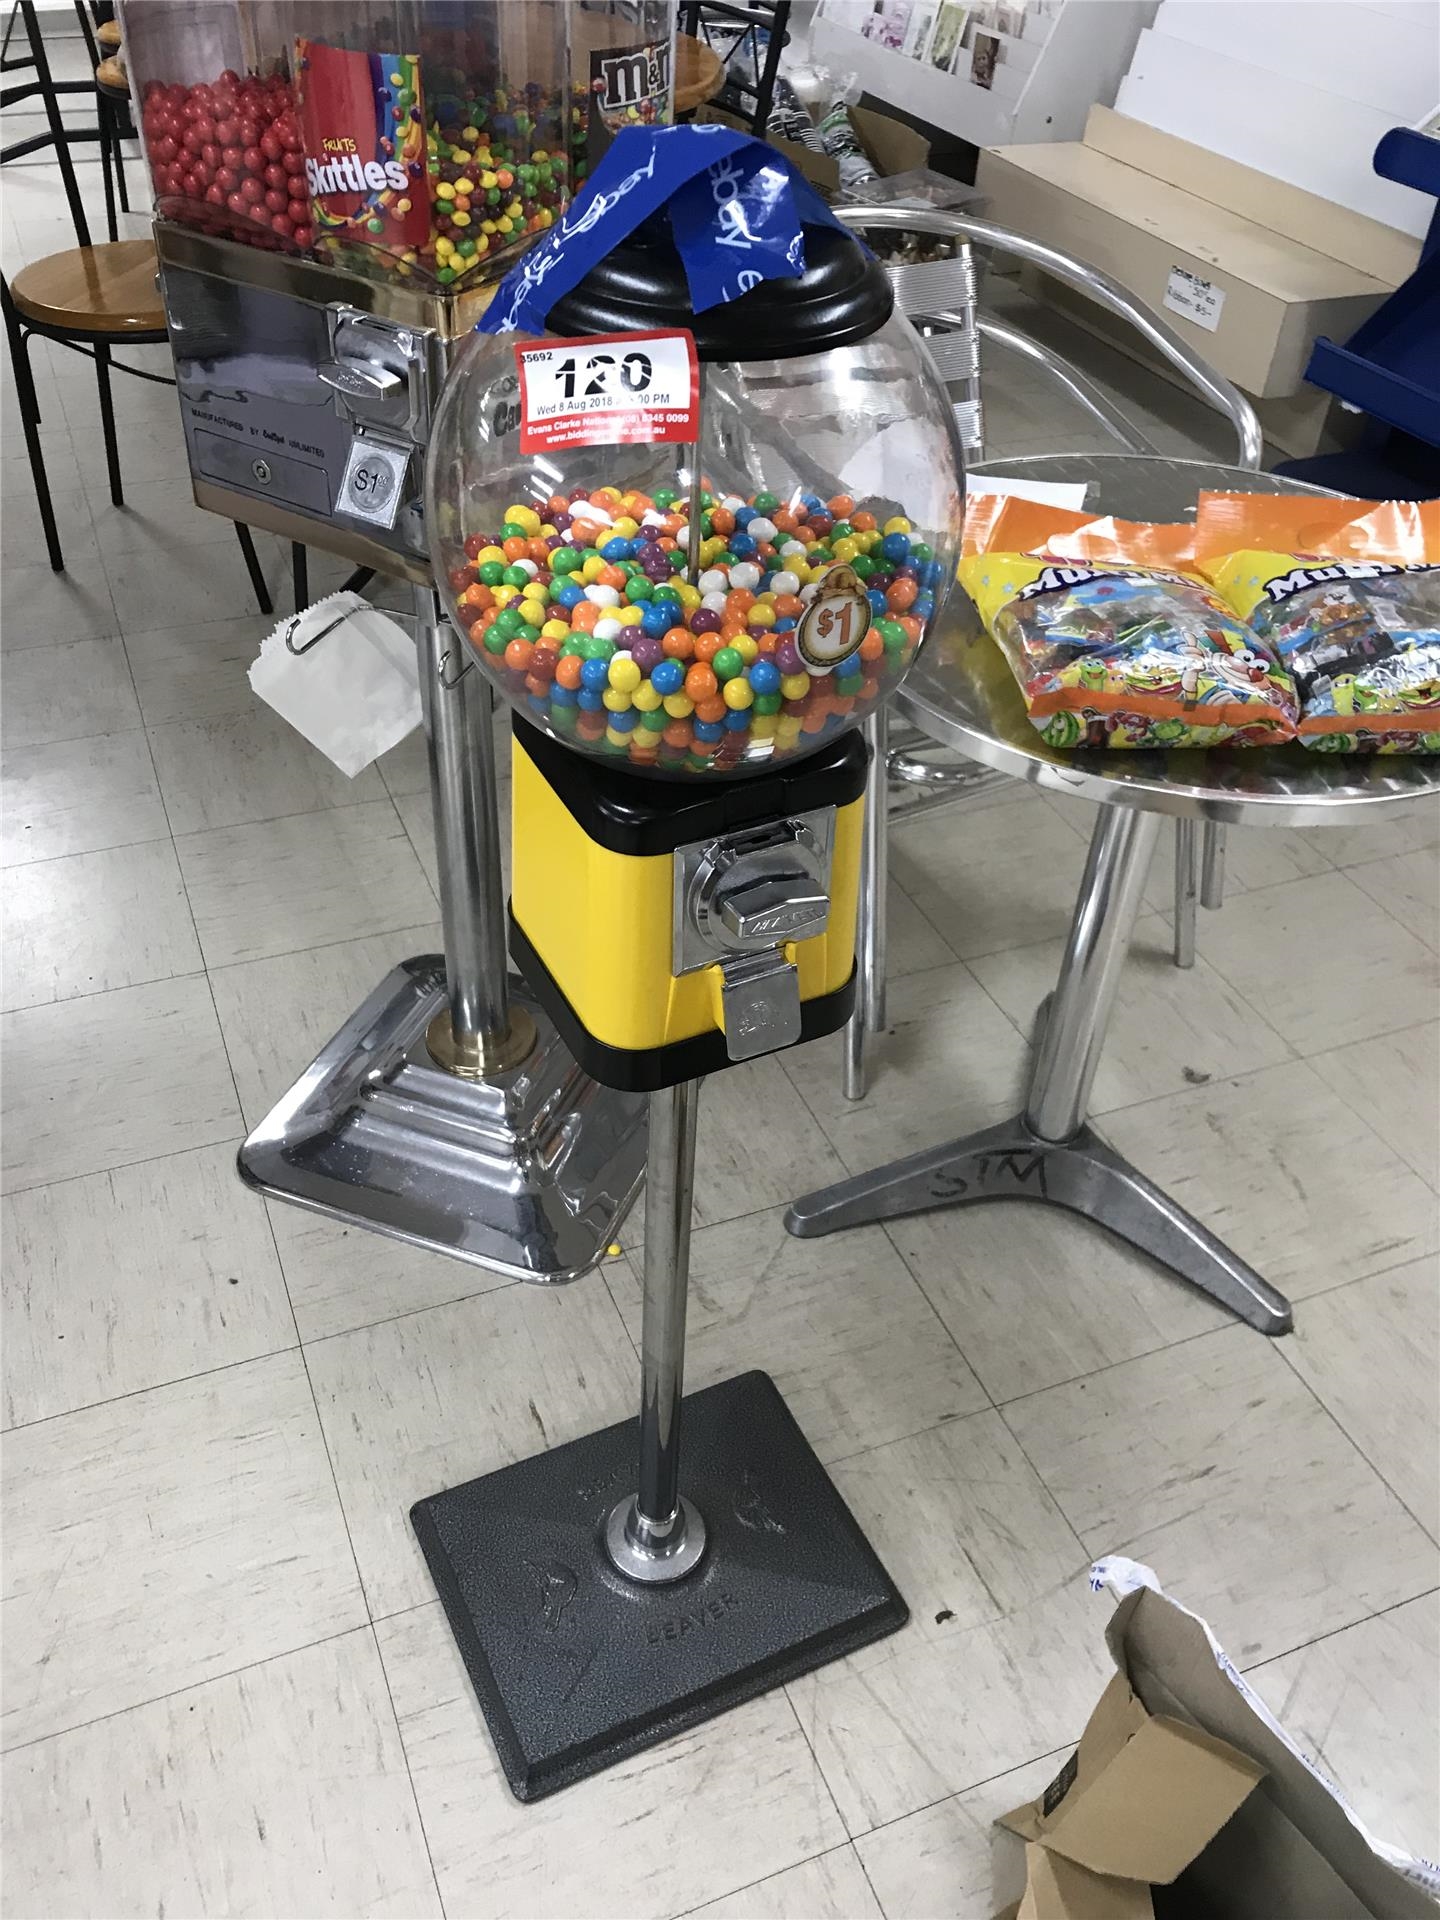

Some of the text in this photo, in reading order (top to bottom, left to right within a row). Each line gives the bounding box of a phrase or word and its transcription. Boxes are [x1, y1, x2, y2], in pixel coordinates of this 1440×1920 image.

[305, 153, 409, 197] Skittles
[555, 352, 653, 398] 120
[527, 423, 552, 435] Evans
[554, 418, 581, 431] Clarke
[666, 413, 689, 423] 0099
[537, 404, 556, 416] Wed
[559, 401, 565, 412] 8
[567, 400, 586, 411] Aug
[590, 396, 613, 408] 2018
[653, 393, 670, 404] PM
[816, 601, 852, 646] $1
